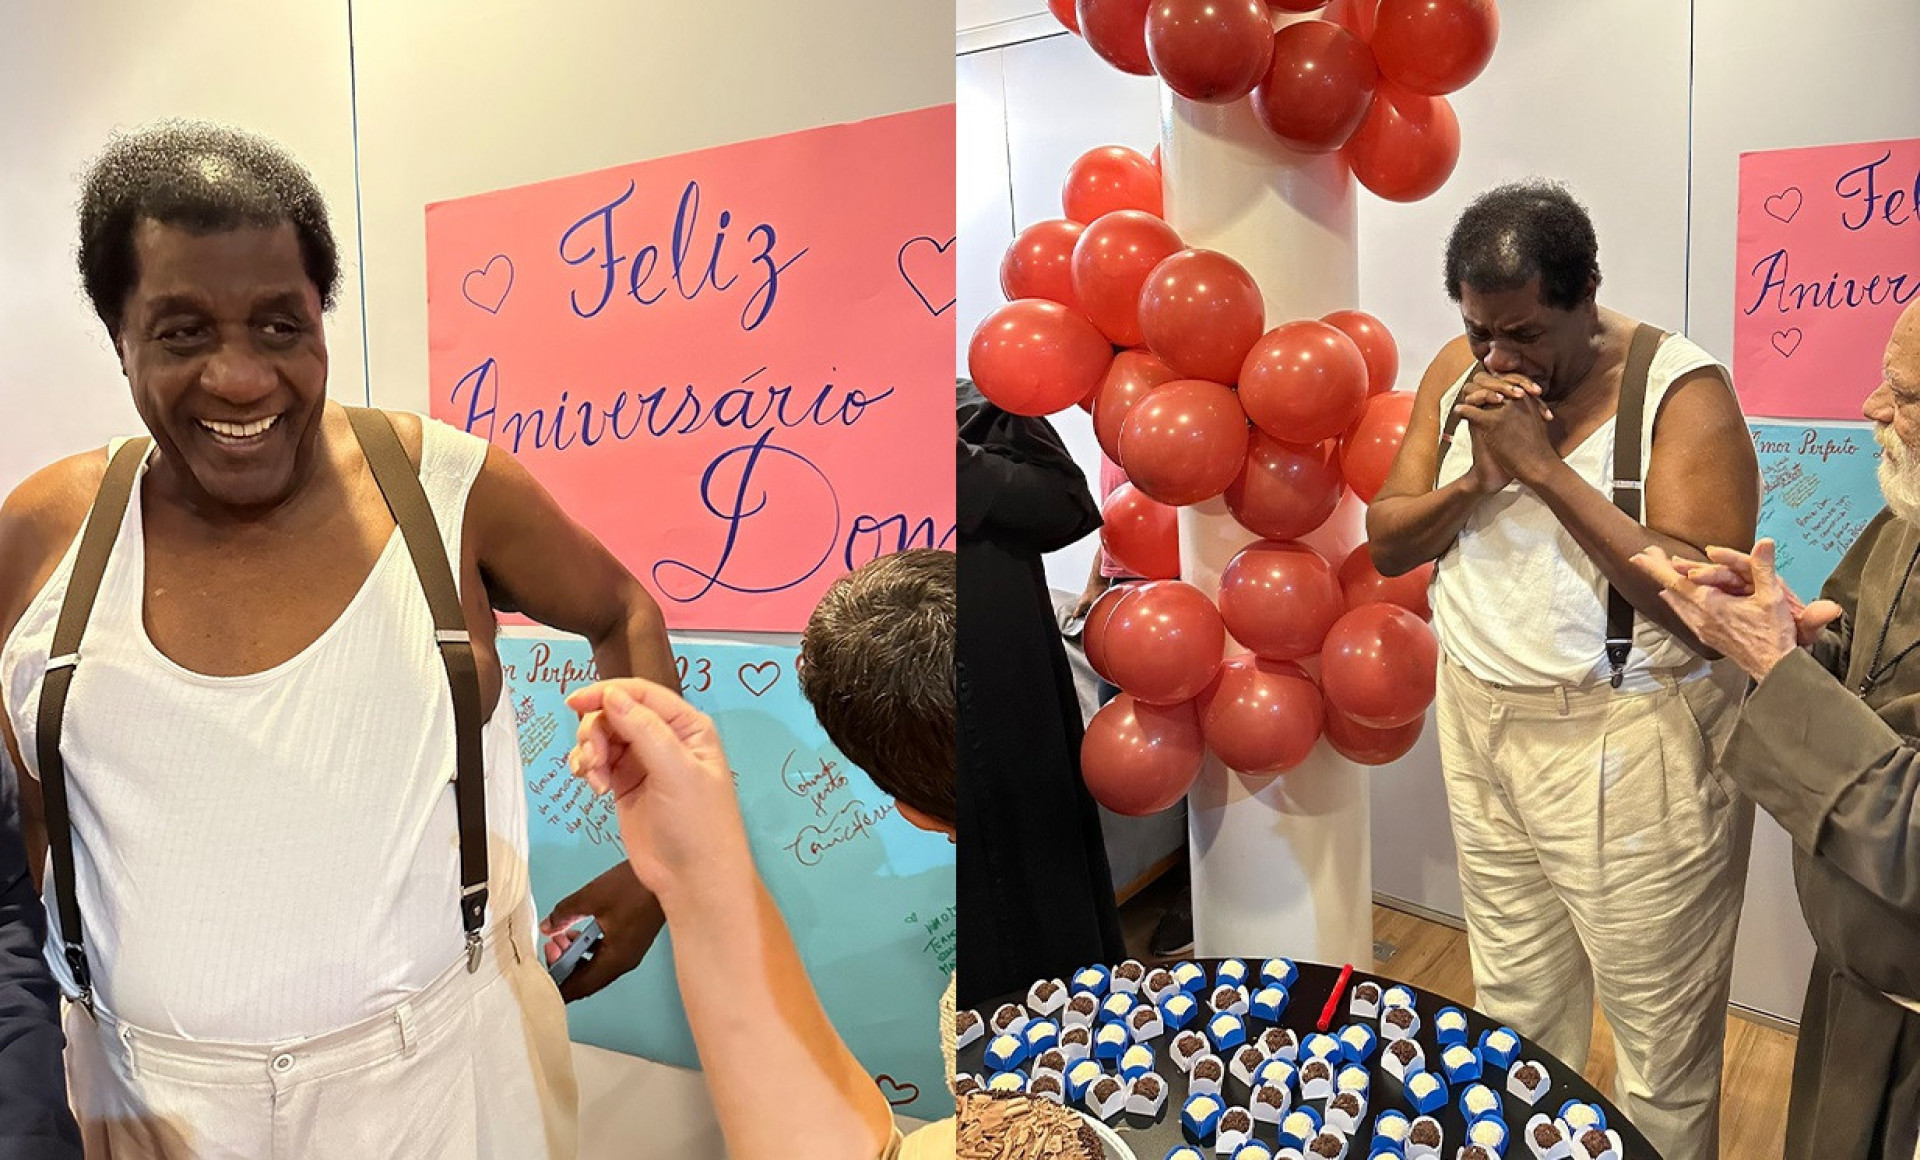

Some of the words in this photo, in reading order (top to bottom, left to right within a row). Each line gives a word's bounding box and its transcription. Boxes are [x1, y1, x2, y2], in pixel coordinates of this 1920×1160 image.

[560, 178, 808, 330] Feliz
[450, 357, 894, 454] Aniversário
[1798, 428, 1859, 462] Perfeito
